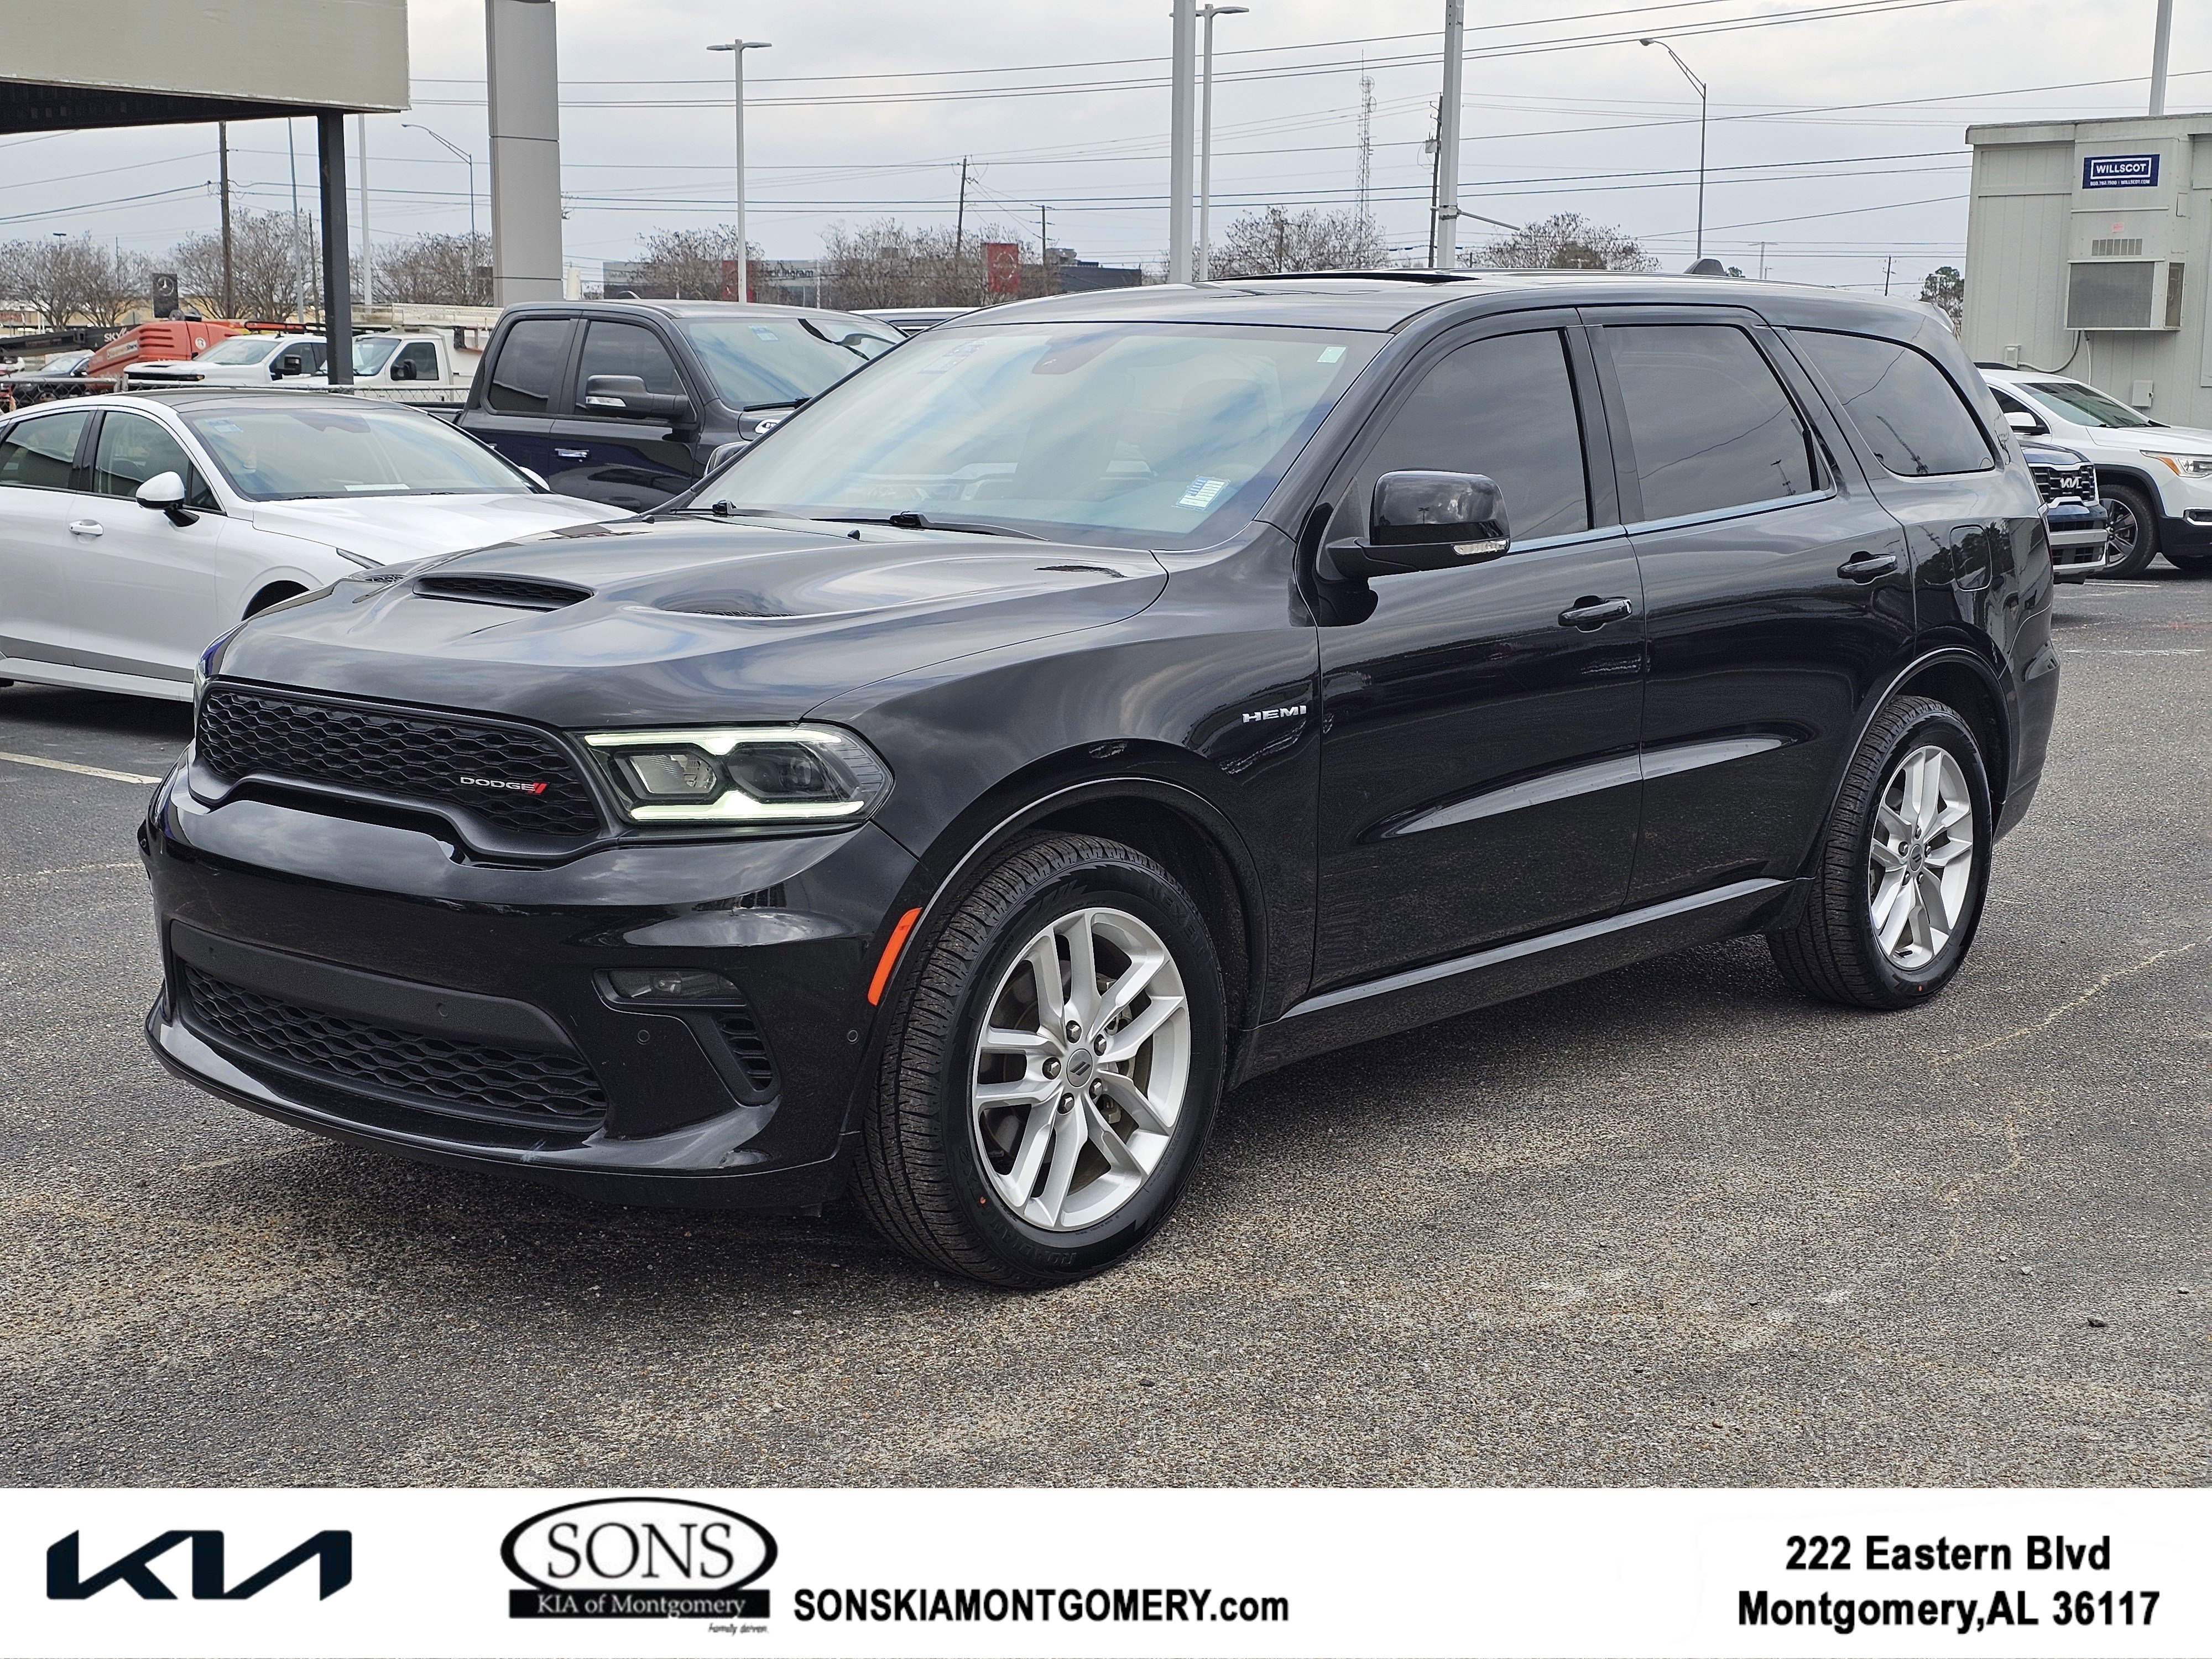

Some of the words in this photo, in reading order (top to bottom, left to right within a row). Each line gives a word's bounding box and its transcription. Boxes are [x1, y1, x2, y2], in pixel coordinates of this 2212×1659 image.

[2096, 163, 2146, 173] WILLSCOT
[1242, 705, 1307, 723] HEMI
[460, 776, 536, 791] DODGE
